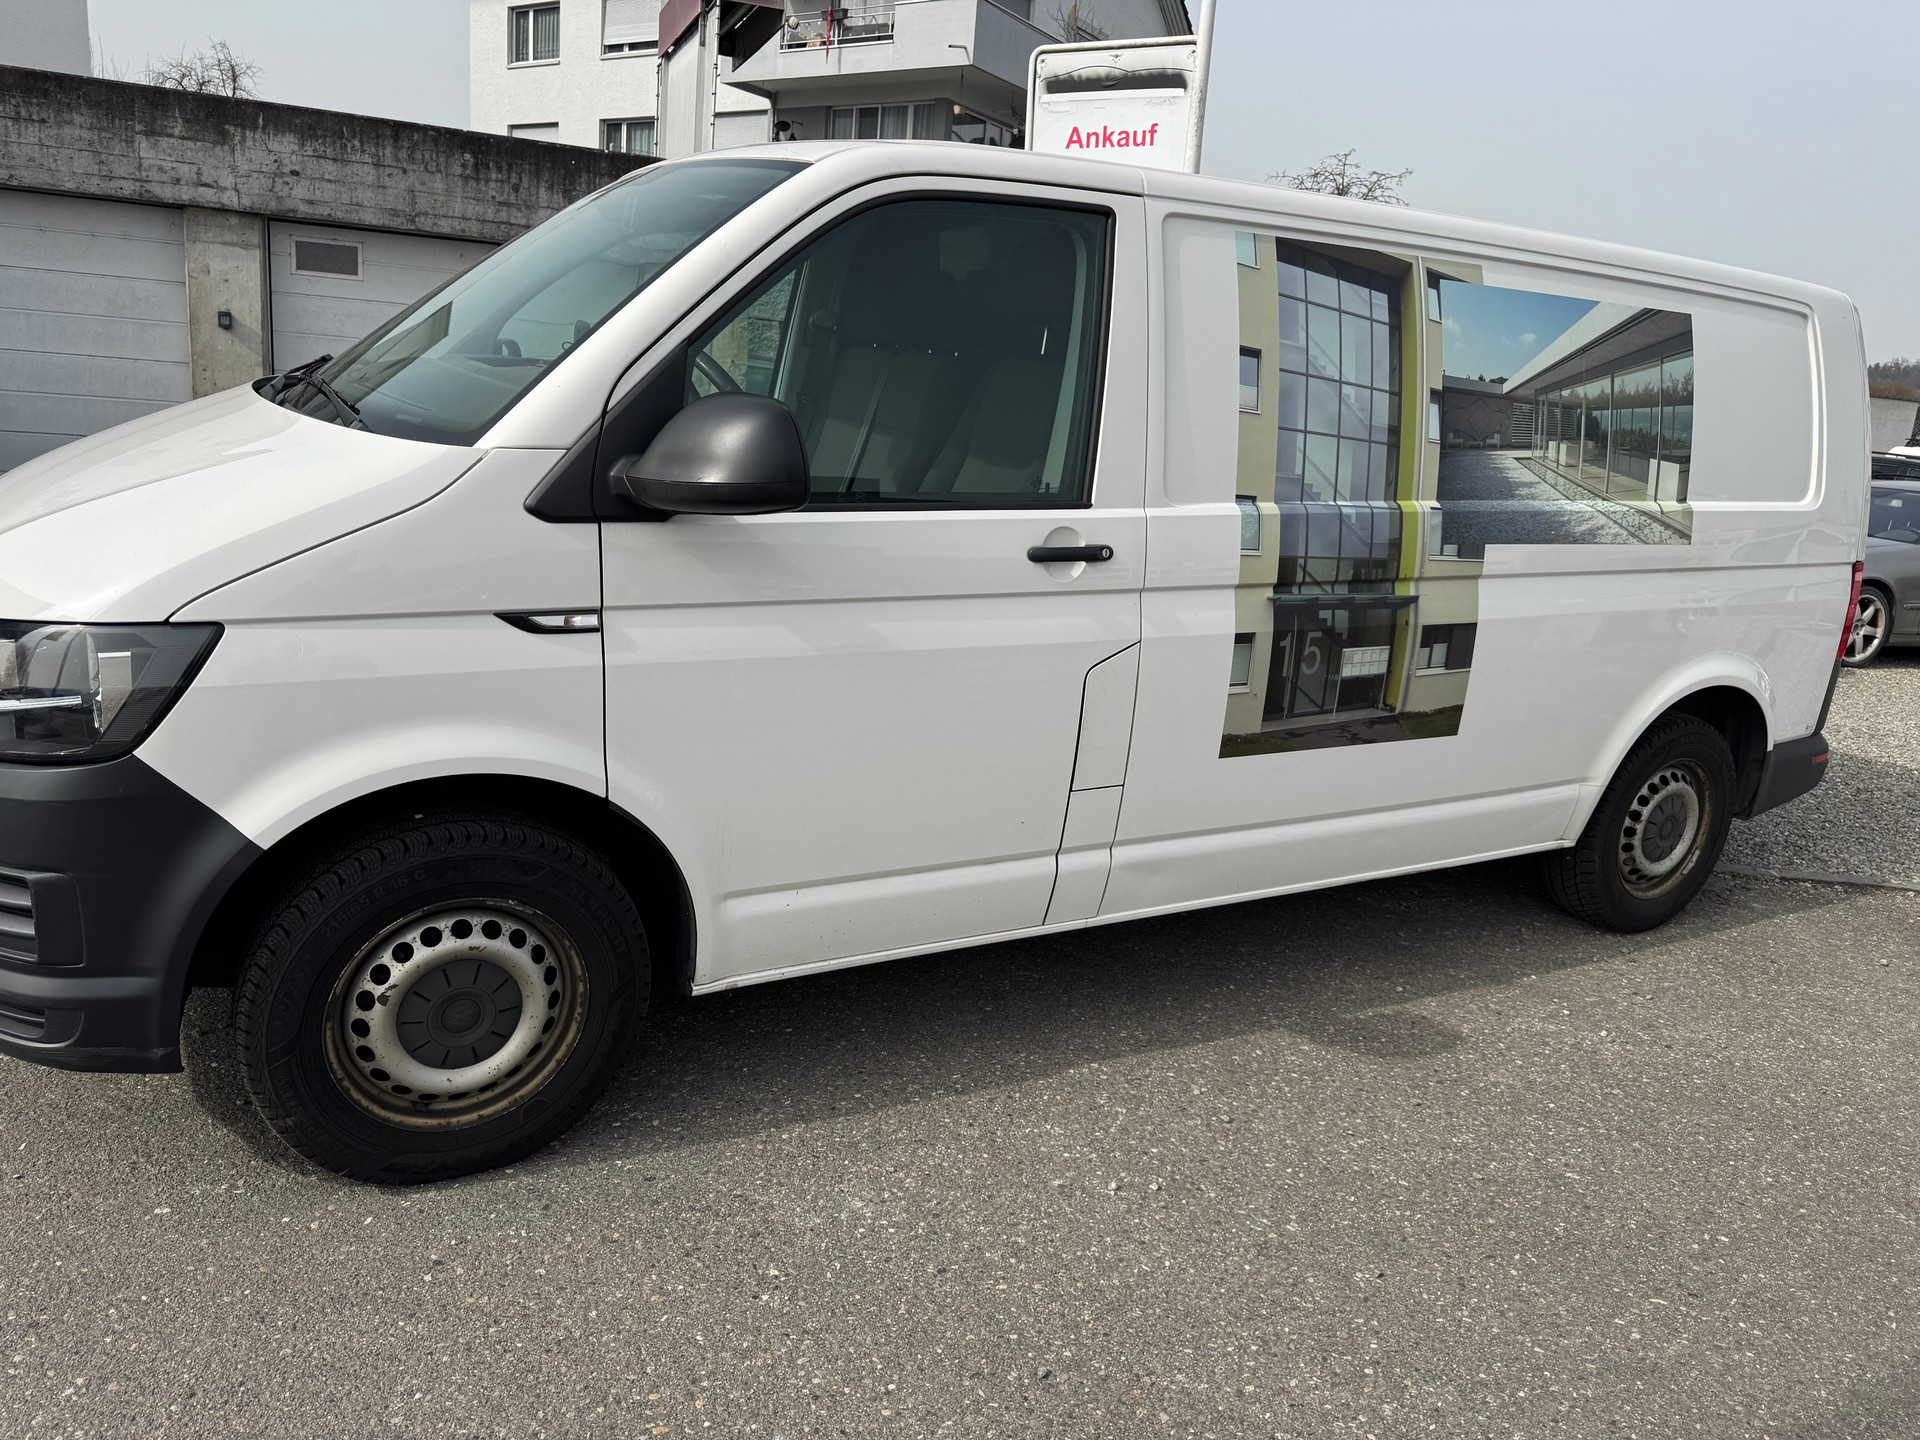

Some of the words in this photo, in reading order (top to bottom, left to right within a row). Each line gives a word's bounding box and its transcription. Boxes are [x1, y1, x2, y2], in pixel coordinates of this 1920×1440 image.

[1065, 122, 1159, 149] Ankauf
[1280, 631, 1322, 676] 15
[323, 895, 371, 938] 215/65
[372, 886, 386, 899] R
[389, 875, 410, 891] 16
[413, 868, 427, 882] C
[567, 883, 629, 955] SEMPERIT
